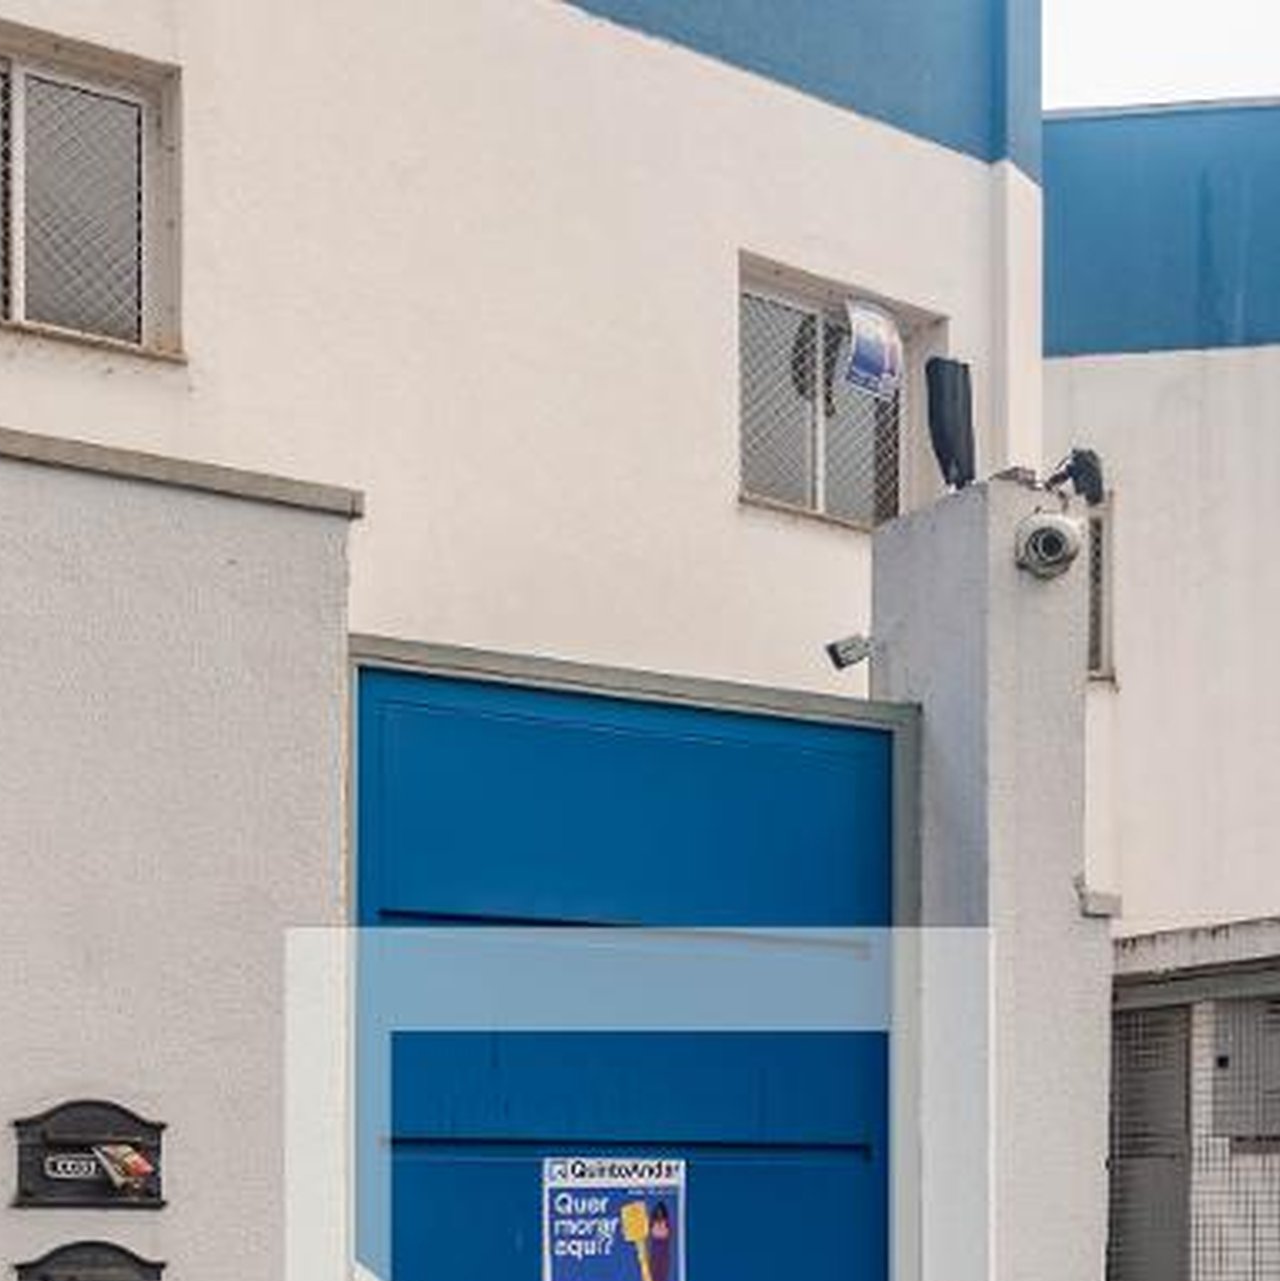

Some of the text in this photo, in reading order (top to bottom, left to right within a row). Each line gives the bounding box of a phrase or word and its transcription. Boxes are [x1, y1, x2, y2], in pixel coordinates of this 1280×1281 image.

[554, 1193, 609, 1215] Quer
[554, 1218, 618, 1239] morar
[554, 1238, 614, 1260] aqui?
